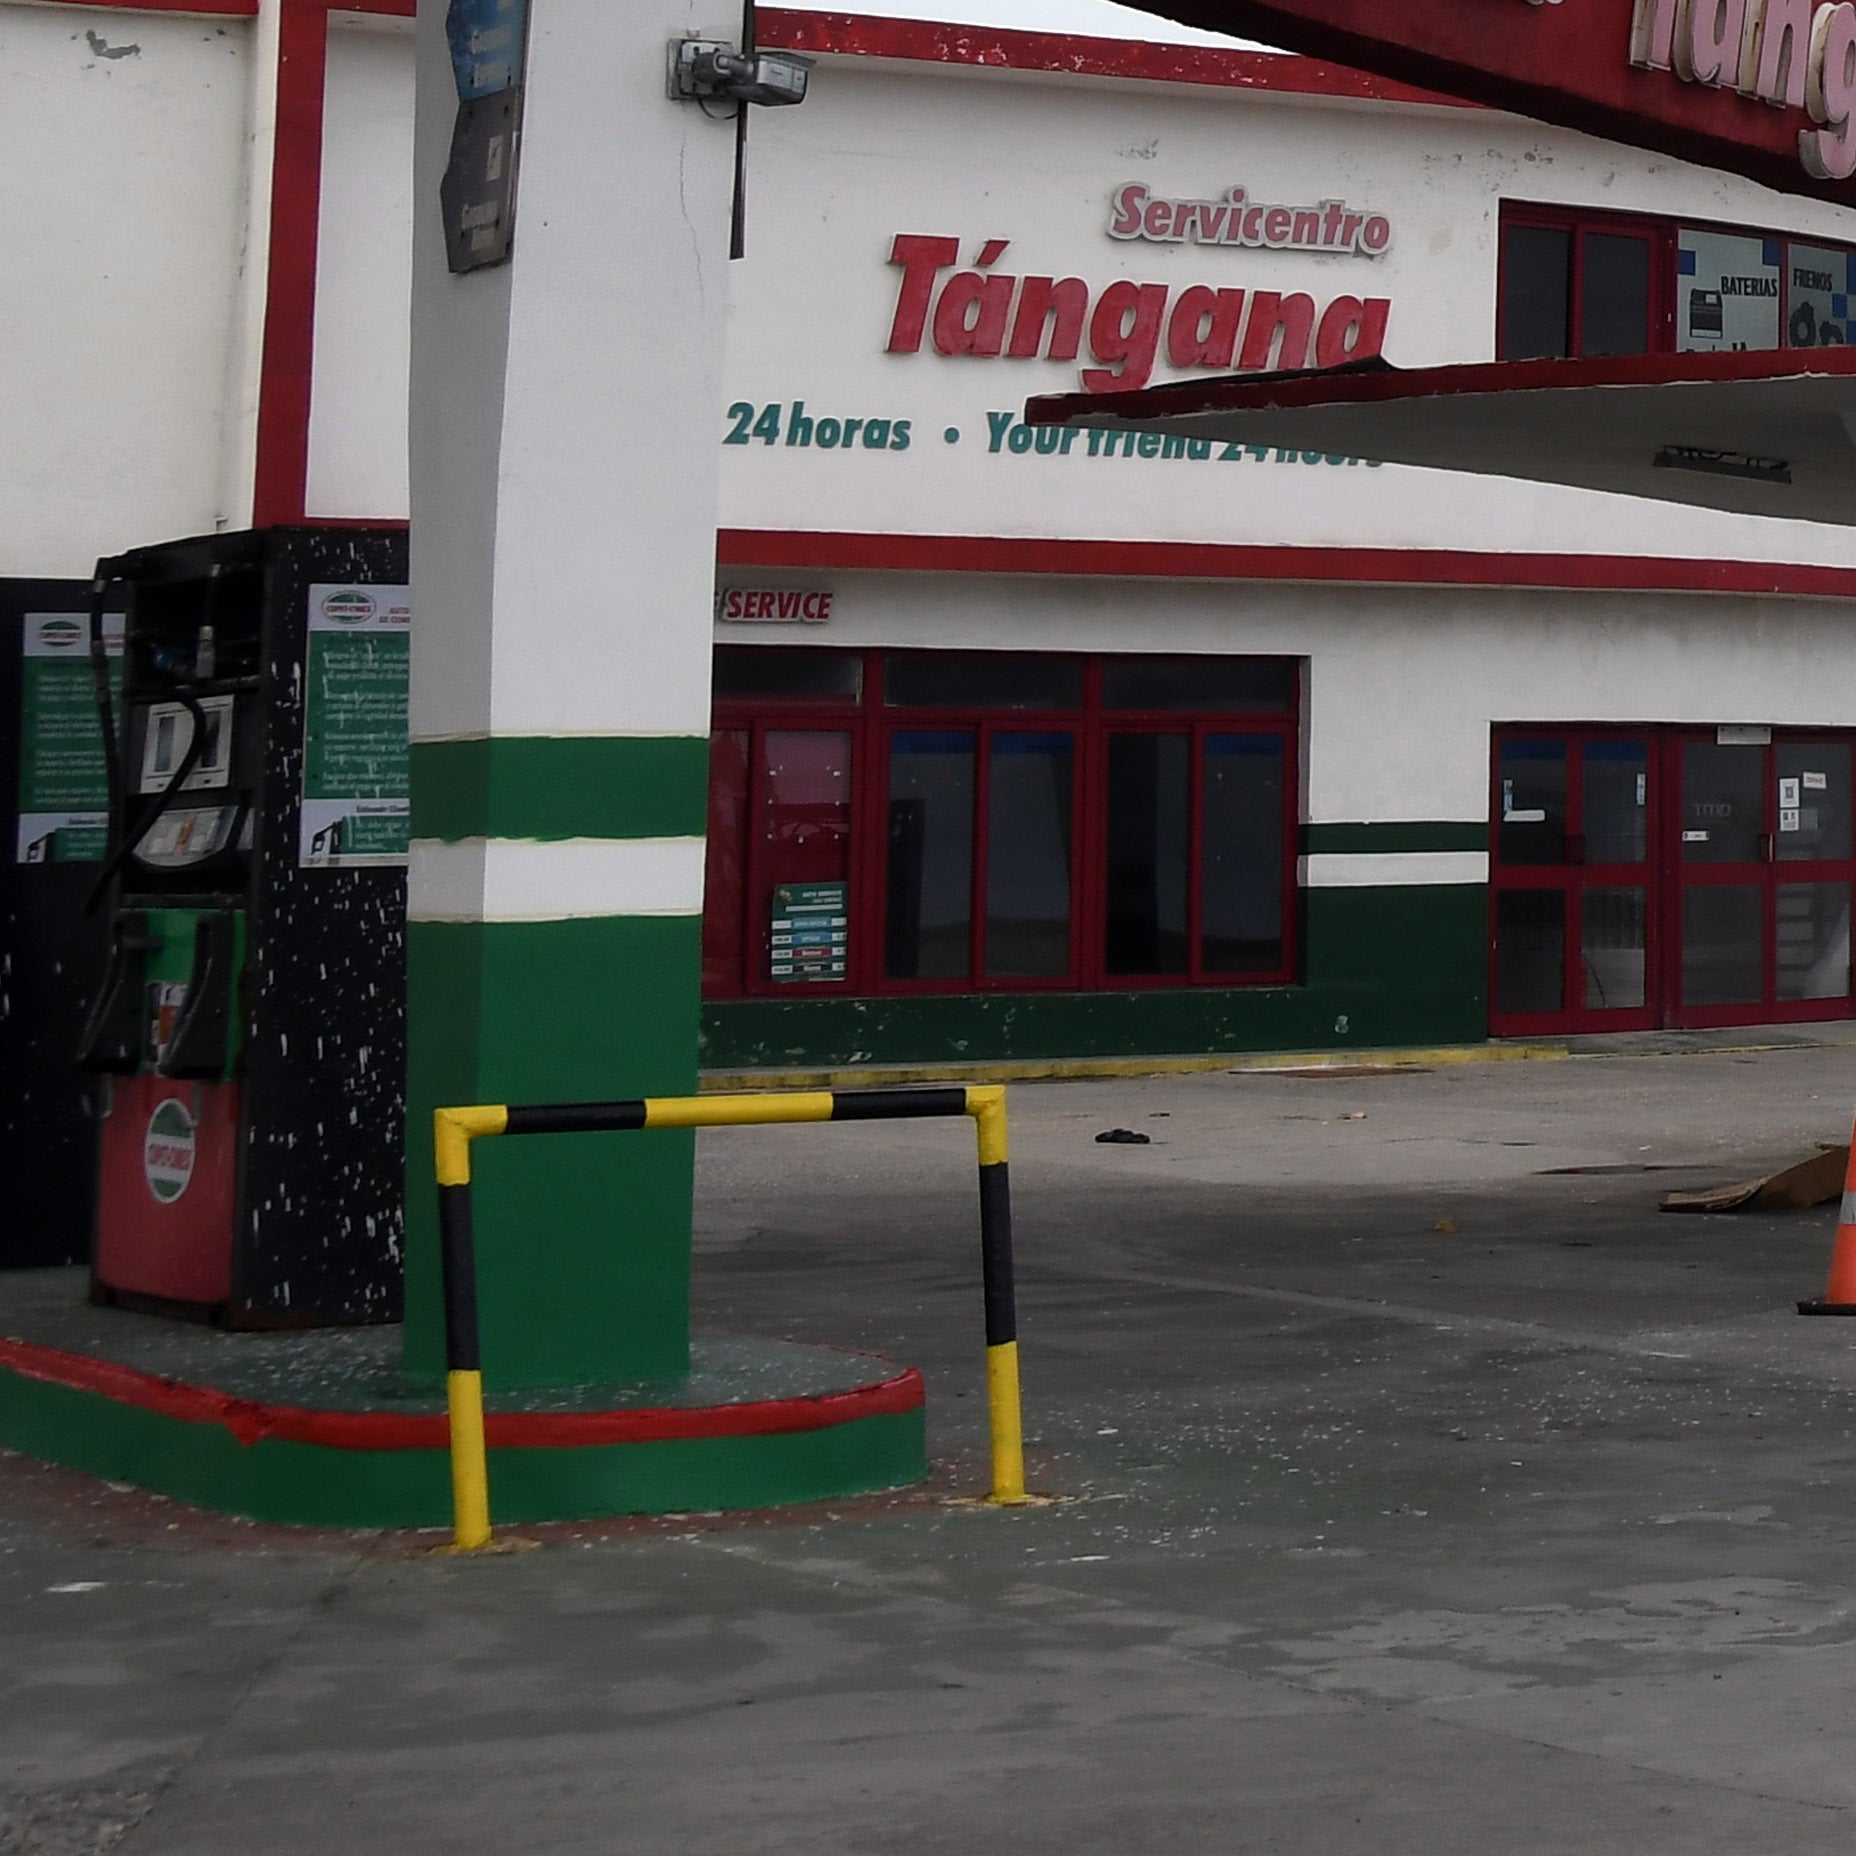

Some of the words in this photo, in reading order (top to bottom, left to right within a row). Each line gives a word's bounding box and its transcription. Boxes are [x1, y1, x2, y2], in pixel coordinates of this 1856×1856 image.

[1111, 184, 1391, 255] Servicentro
[1720, 275, 1778, 298] BATERIAS
[1792, 268, 1833, 293] FRENOS
[887, 233, 1391, 393] Tángana
[722, 401, 782, 445] 24
[785, 400, 912, 451] horas
[986, 411, 1080, 454] Your
[727, 590, 833, 619] SERVICE
